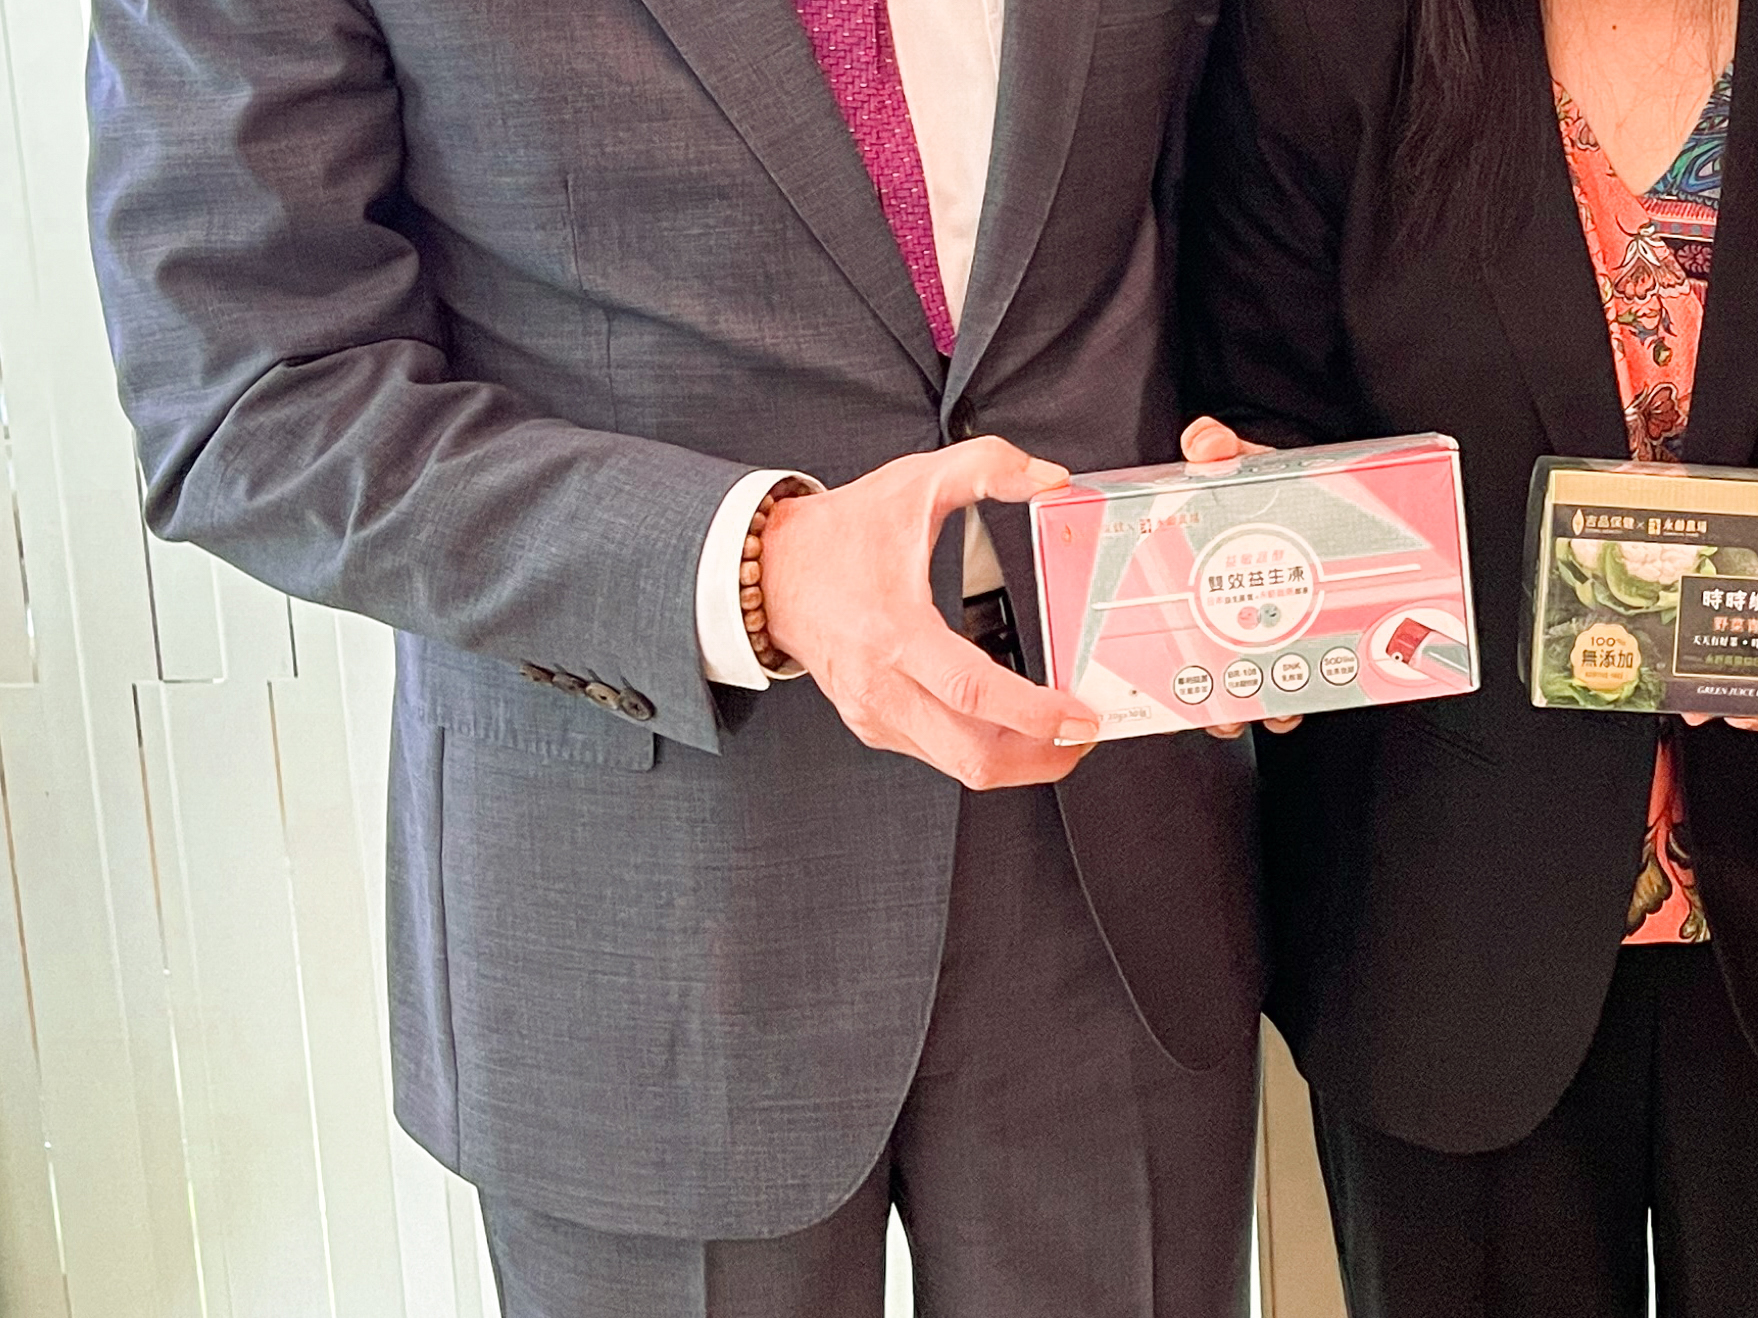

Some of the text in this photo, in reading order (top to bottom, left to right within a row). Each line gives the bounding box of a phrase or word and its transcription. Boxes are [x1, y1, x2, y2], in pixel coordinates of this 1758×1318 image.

[1207, 565, 1306, 593] 雙效益生凍
[1591, 636, 1626, 647] 100%
[1581, 648, 1634, 669] 無添加
[1696, 685, 1728, 696] GREEN
[1728, 686, 1756, 697] JUICE
